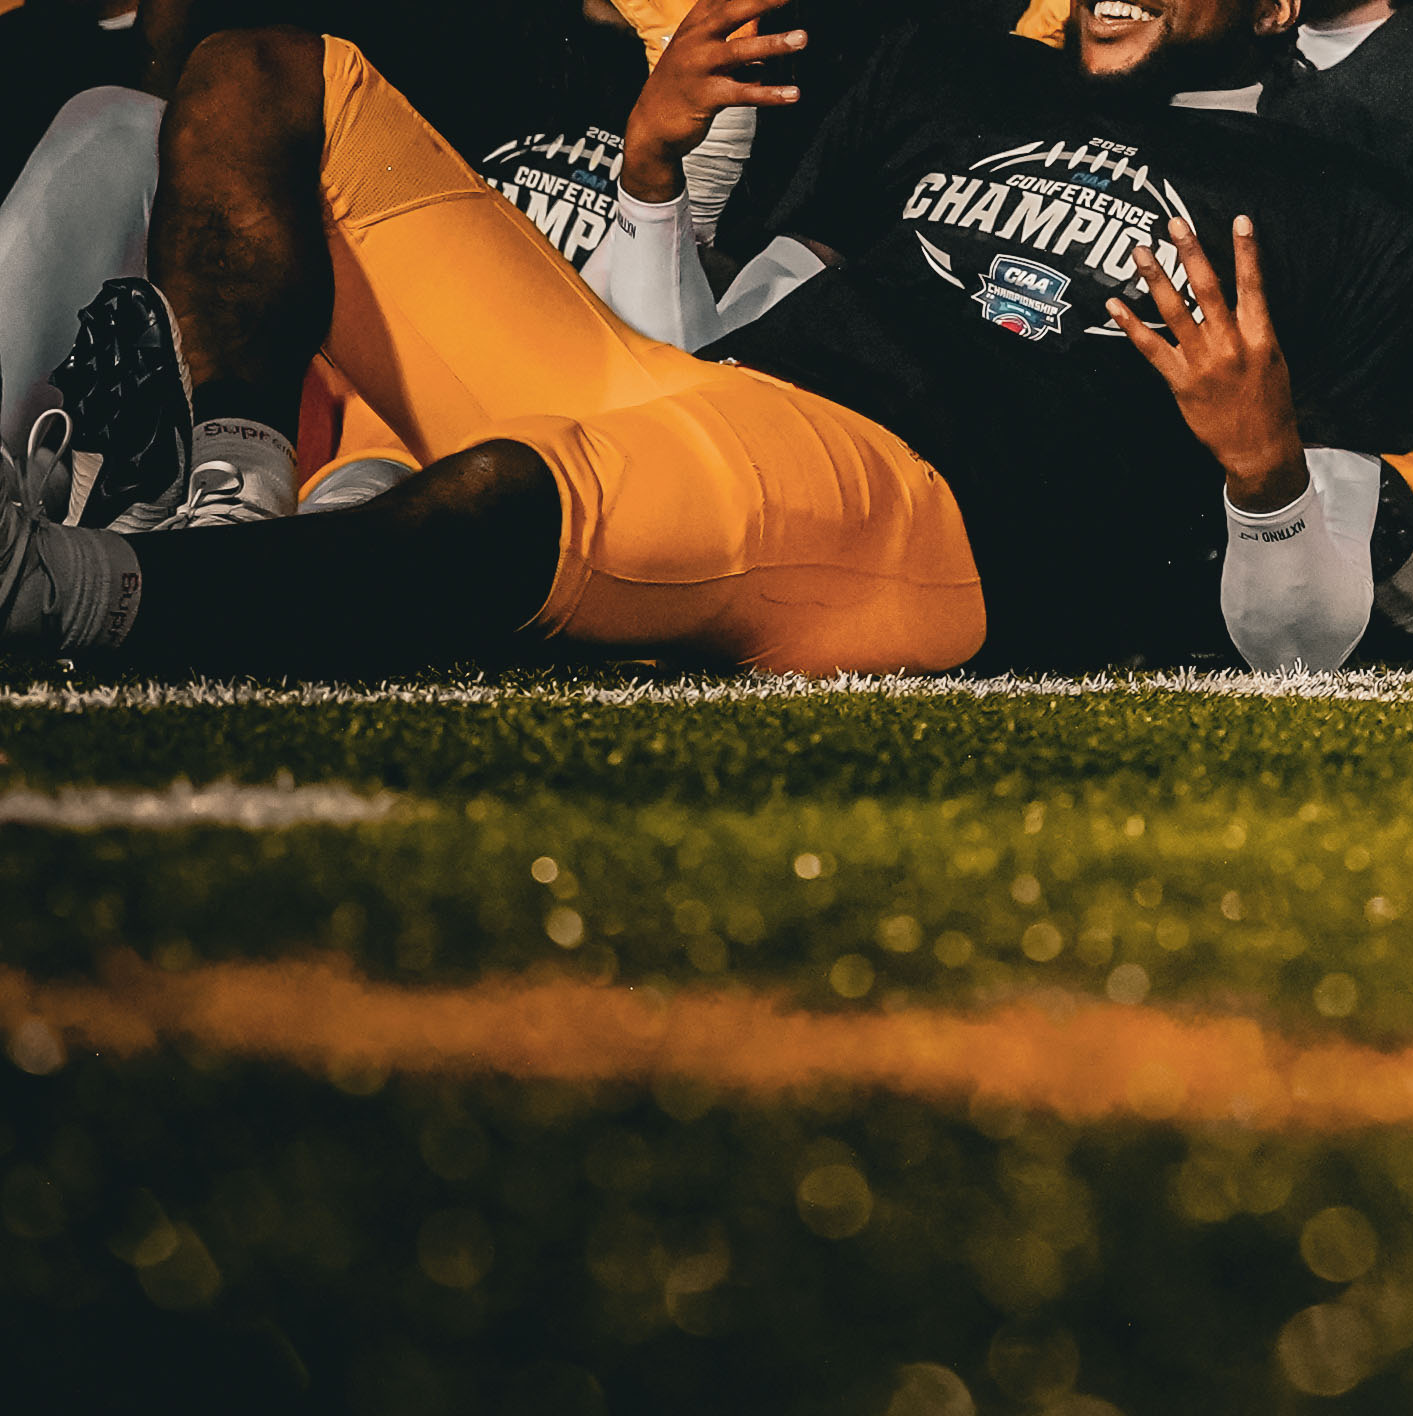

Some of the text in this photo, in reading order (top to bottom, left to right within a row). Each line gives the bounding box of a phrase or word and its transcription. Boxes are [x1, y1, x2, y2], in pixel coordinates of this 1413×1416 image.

[1088, 137, 1139, 159] 2025
[513, 165, 620, 220] CONFEREN
[1004, 173, 1160, 233] CONFERENCE
[902, 172, 1206, 325] CHAMPION
[1003, 266, 1050, 295] CIAA
[986, 282, 1060, 316] CHAMPIONSHIP
[1261, 517, 1306, 543] NXTRND
